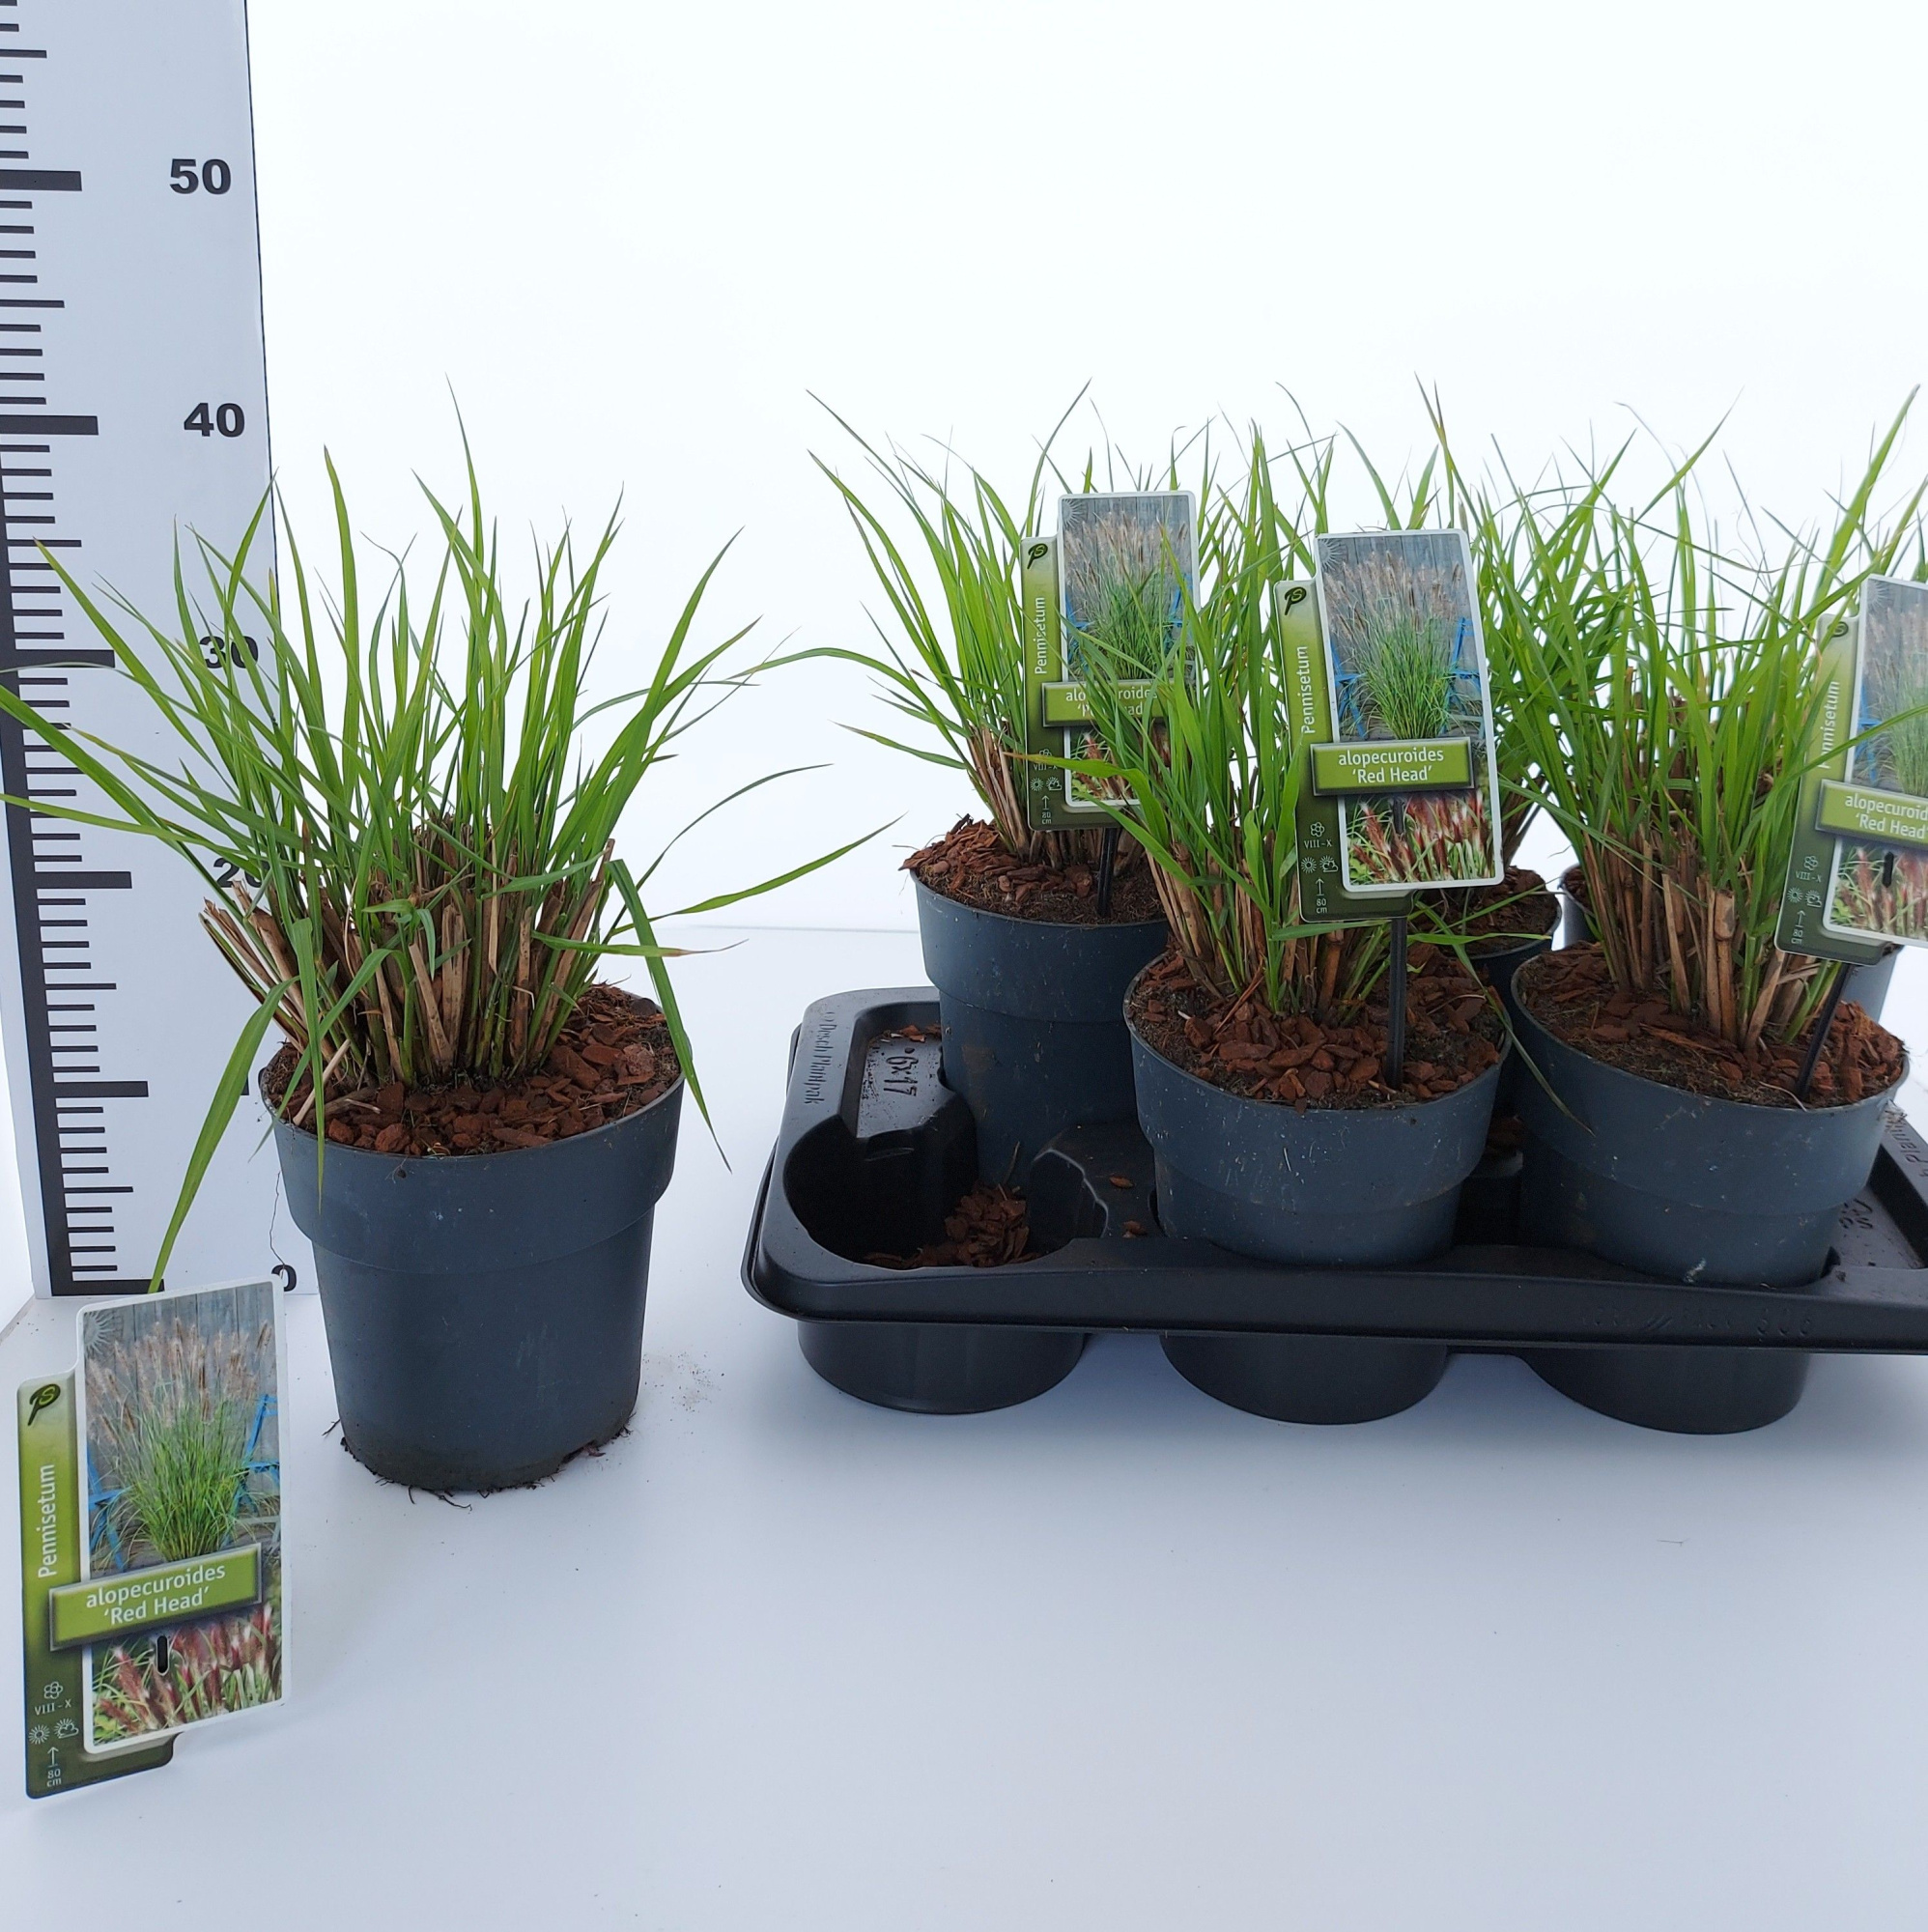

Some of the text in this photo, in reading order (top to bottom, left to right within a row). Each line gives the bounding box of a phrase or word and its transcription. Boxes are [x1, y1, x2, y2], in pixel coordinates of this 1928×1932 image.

[170, 158, 231, 195] 50
[184, 402, 245, 438] 40
[199, 636, 259, 668] 30
[1033, 597, 1047, 674] Pennisetum
[1296, 645, 1316, 734] Pennisetum
[1817, 681, 1840, 770] nnisetum
[1339, 747, 1444, 768] alopecuroides
[1890, 819, 1928, 839] Head
[36, 1463, 57, 1578] Pennisetum
[86, 1564, 226, 1608] alopecuroides
[46, 1778, 62, 1787] cm
[47, 1768, 61, 1779] 80
